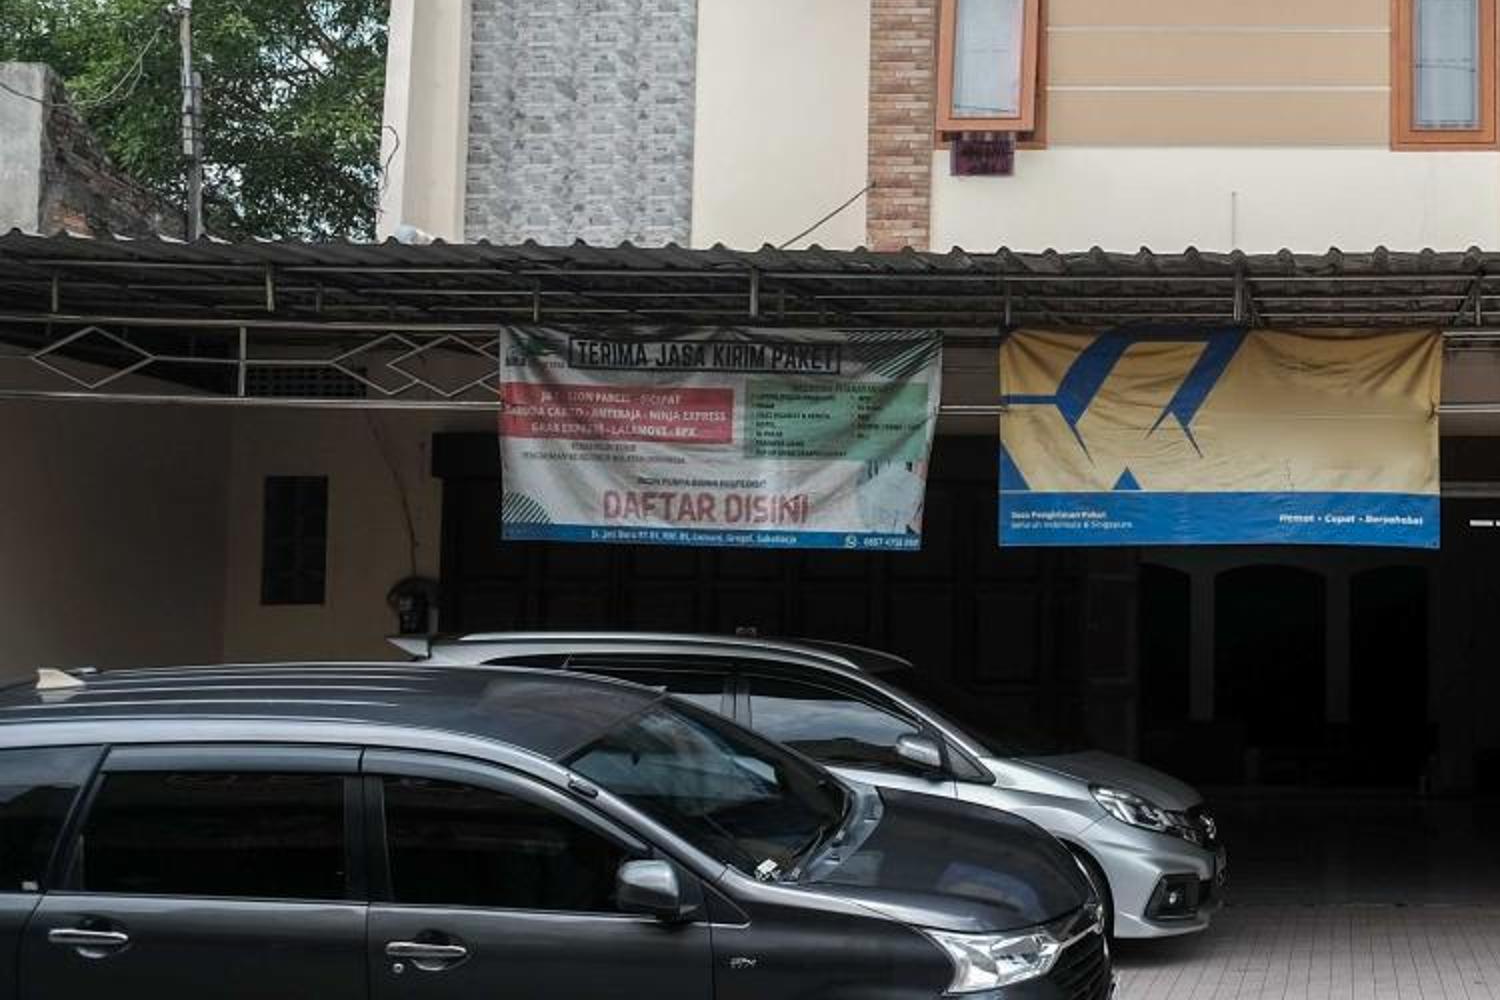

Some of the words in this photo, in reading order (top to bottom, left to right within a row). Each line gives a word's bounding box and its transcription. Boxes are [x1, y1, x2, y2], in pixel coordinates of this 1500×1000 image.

[577, 341, 648, 366] TERIMA
[656, 343, 705, 367] JASA
[712, 343, 765, 369] KIRIM
[771, 344, 832, 370] PAKET
[681, 411, 726, 422] EXPRESS
[603, 489, 716, 522] DAFTAR
[724, 492, 809, 524] DISINI
